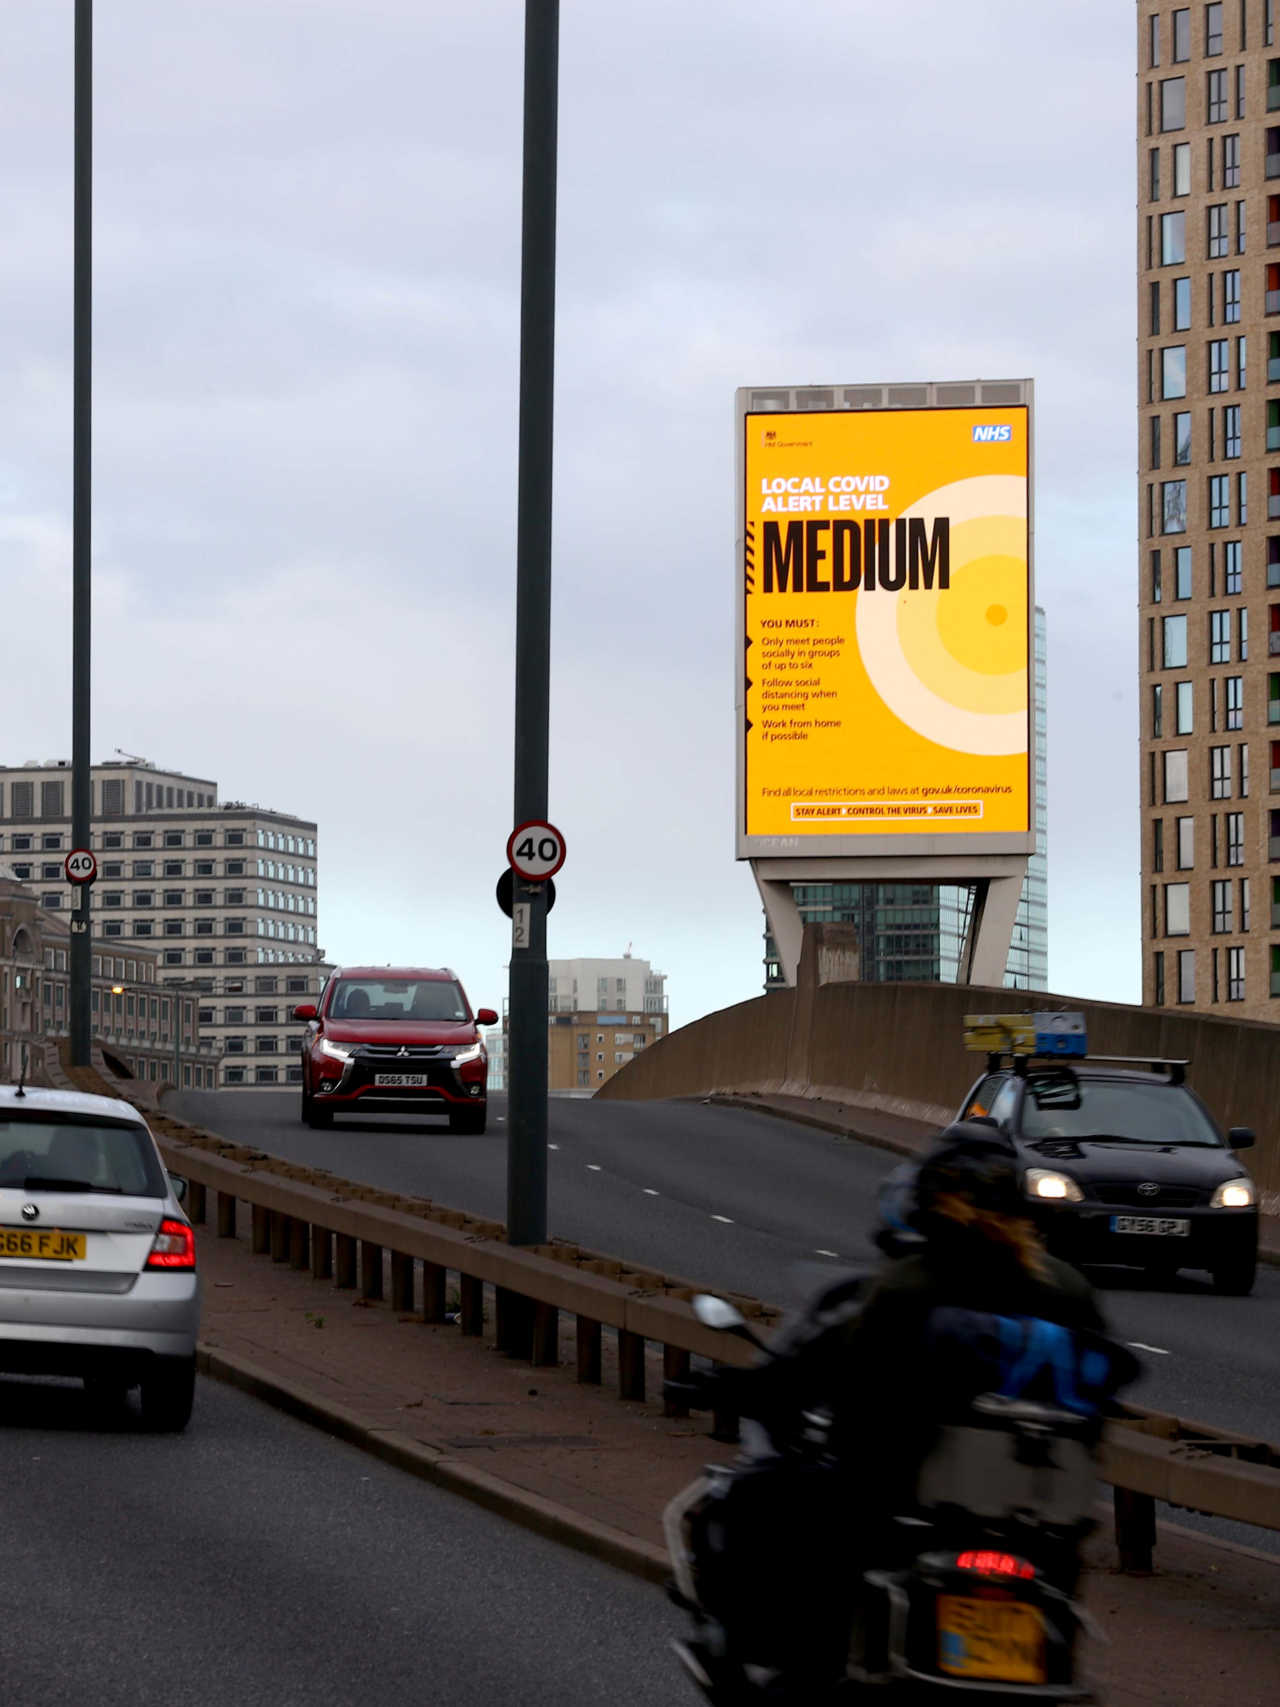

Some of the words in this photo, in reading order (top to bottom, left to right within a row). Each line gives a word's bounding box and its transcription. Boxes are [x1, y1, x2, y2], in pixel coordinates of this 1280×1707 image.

[974, 426, 1010, 441] NHS
[761, 477, 826, 494] LOCAL
[828, 475, 890, 493] COVID
[761, 495, 824, 513] ALERT
[828, 493, 889, 511] LEVEL
[763, 517, 950, 593] MEDIUM
[760, 619, 783, 628] YOU
[785, 619, 820, 628] MUST:
[761, 637, 783, 647] Only
[812, 636, 845, 646] people
[762, 649, 794, 659] socially
[797, 649, 805, 657] in
[808, 649, 840, 659] groups
[762, 661, 772, 669] of
[775, 662, 786, 671] up
[789, 661, 798, 669] to
[800, 661, 813, 669] six
[762, 678, 793, 687] Follow
[795, 678, 820, 686] social
[762, 690, 808, 700] distancing
[811, 690, 837, 698] when
[762, 703, 779, 712] you
[761, 720, 786, 728] Work
[790, 719, 811, 728] from
[815, 718, 841, 727] home
[762, 732, 768, 740] if
[770, 731, 808, 741] possible
[762, 787, 781, 797] Find
[782, 787, 791, 796] all
[793, 786, 813, 796] local
[815, 785, 865, 796] restrictions
[867, 785, 885, 795] and
[888, 785, 907, 795] laws
[910, 785, 919, 795] at
[922, 784, 1012, 797] gov.uk/coronavirus
[795, 808, 815, 816] STAY
[847, 807, 884, 815] CONTROL
[933, 806, 952, 814] SAVE
[955, 806, 977, 814] LIVES
[516, 837, 558, 862] 40
[70, 857, 92, 871] 40
